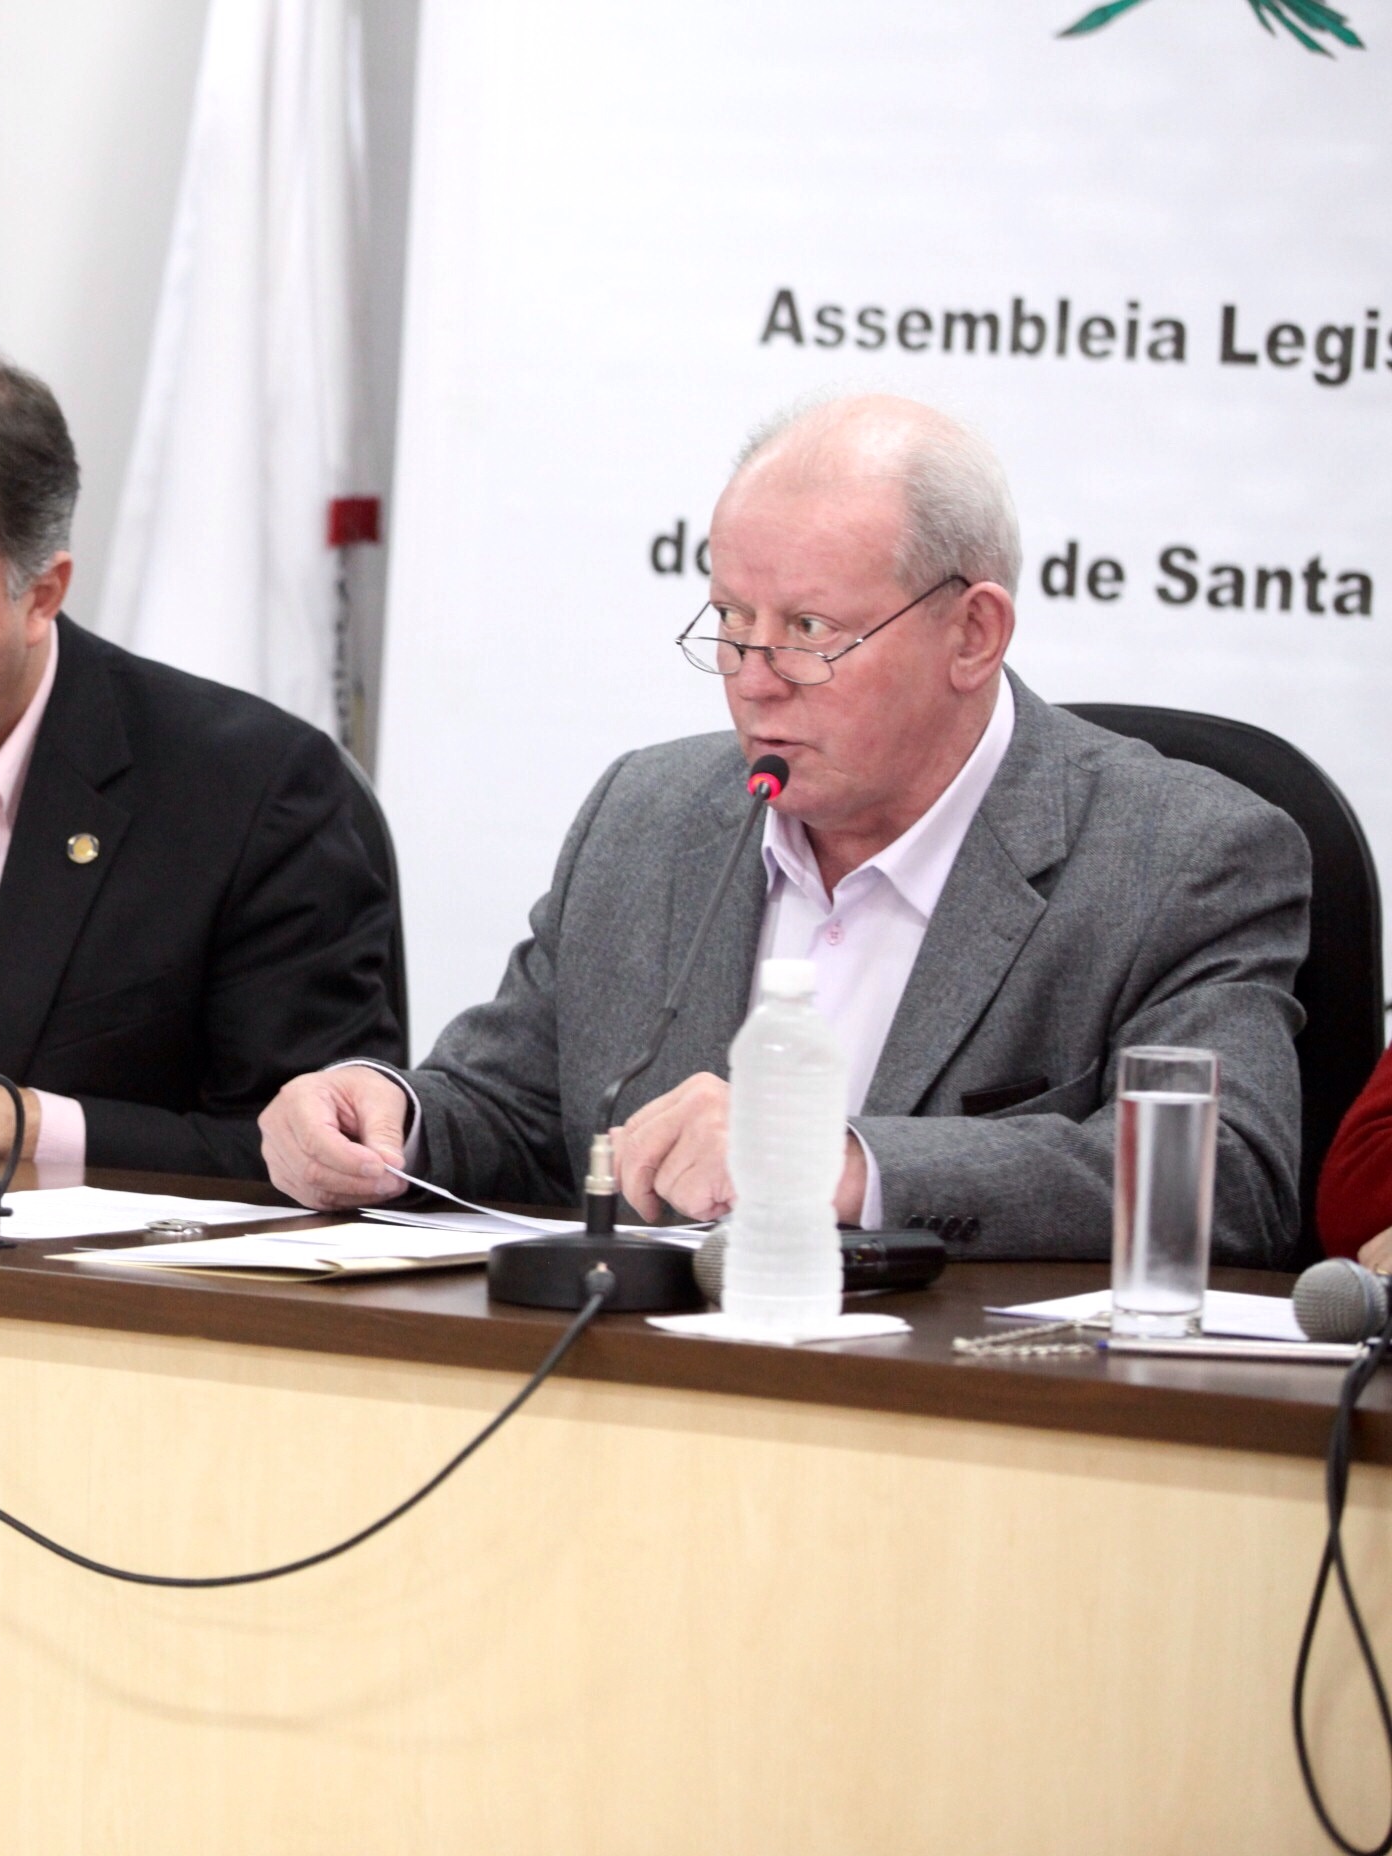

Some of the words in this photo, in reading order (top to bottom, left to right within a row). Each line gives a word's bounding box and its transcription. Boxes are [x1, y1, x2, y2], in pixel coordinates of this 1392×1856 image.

[760, 288, 1187, 363] Assembleia
[1219, 303, 1392, 388] Legi
[1039, 540, 1127, 602] de
[1155, 545, 1375, 617] Santa
